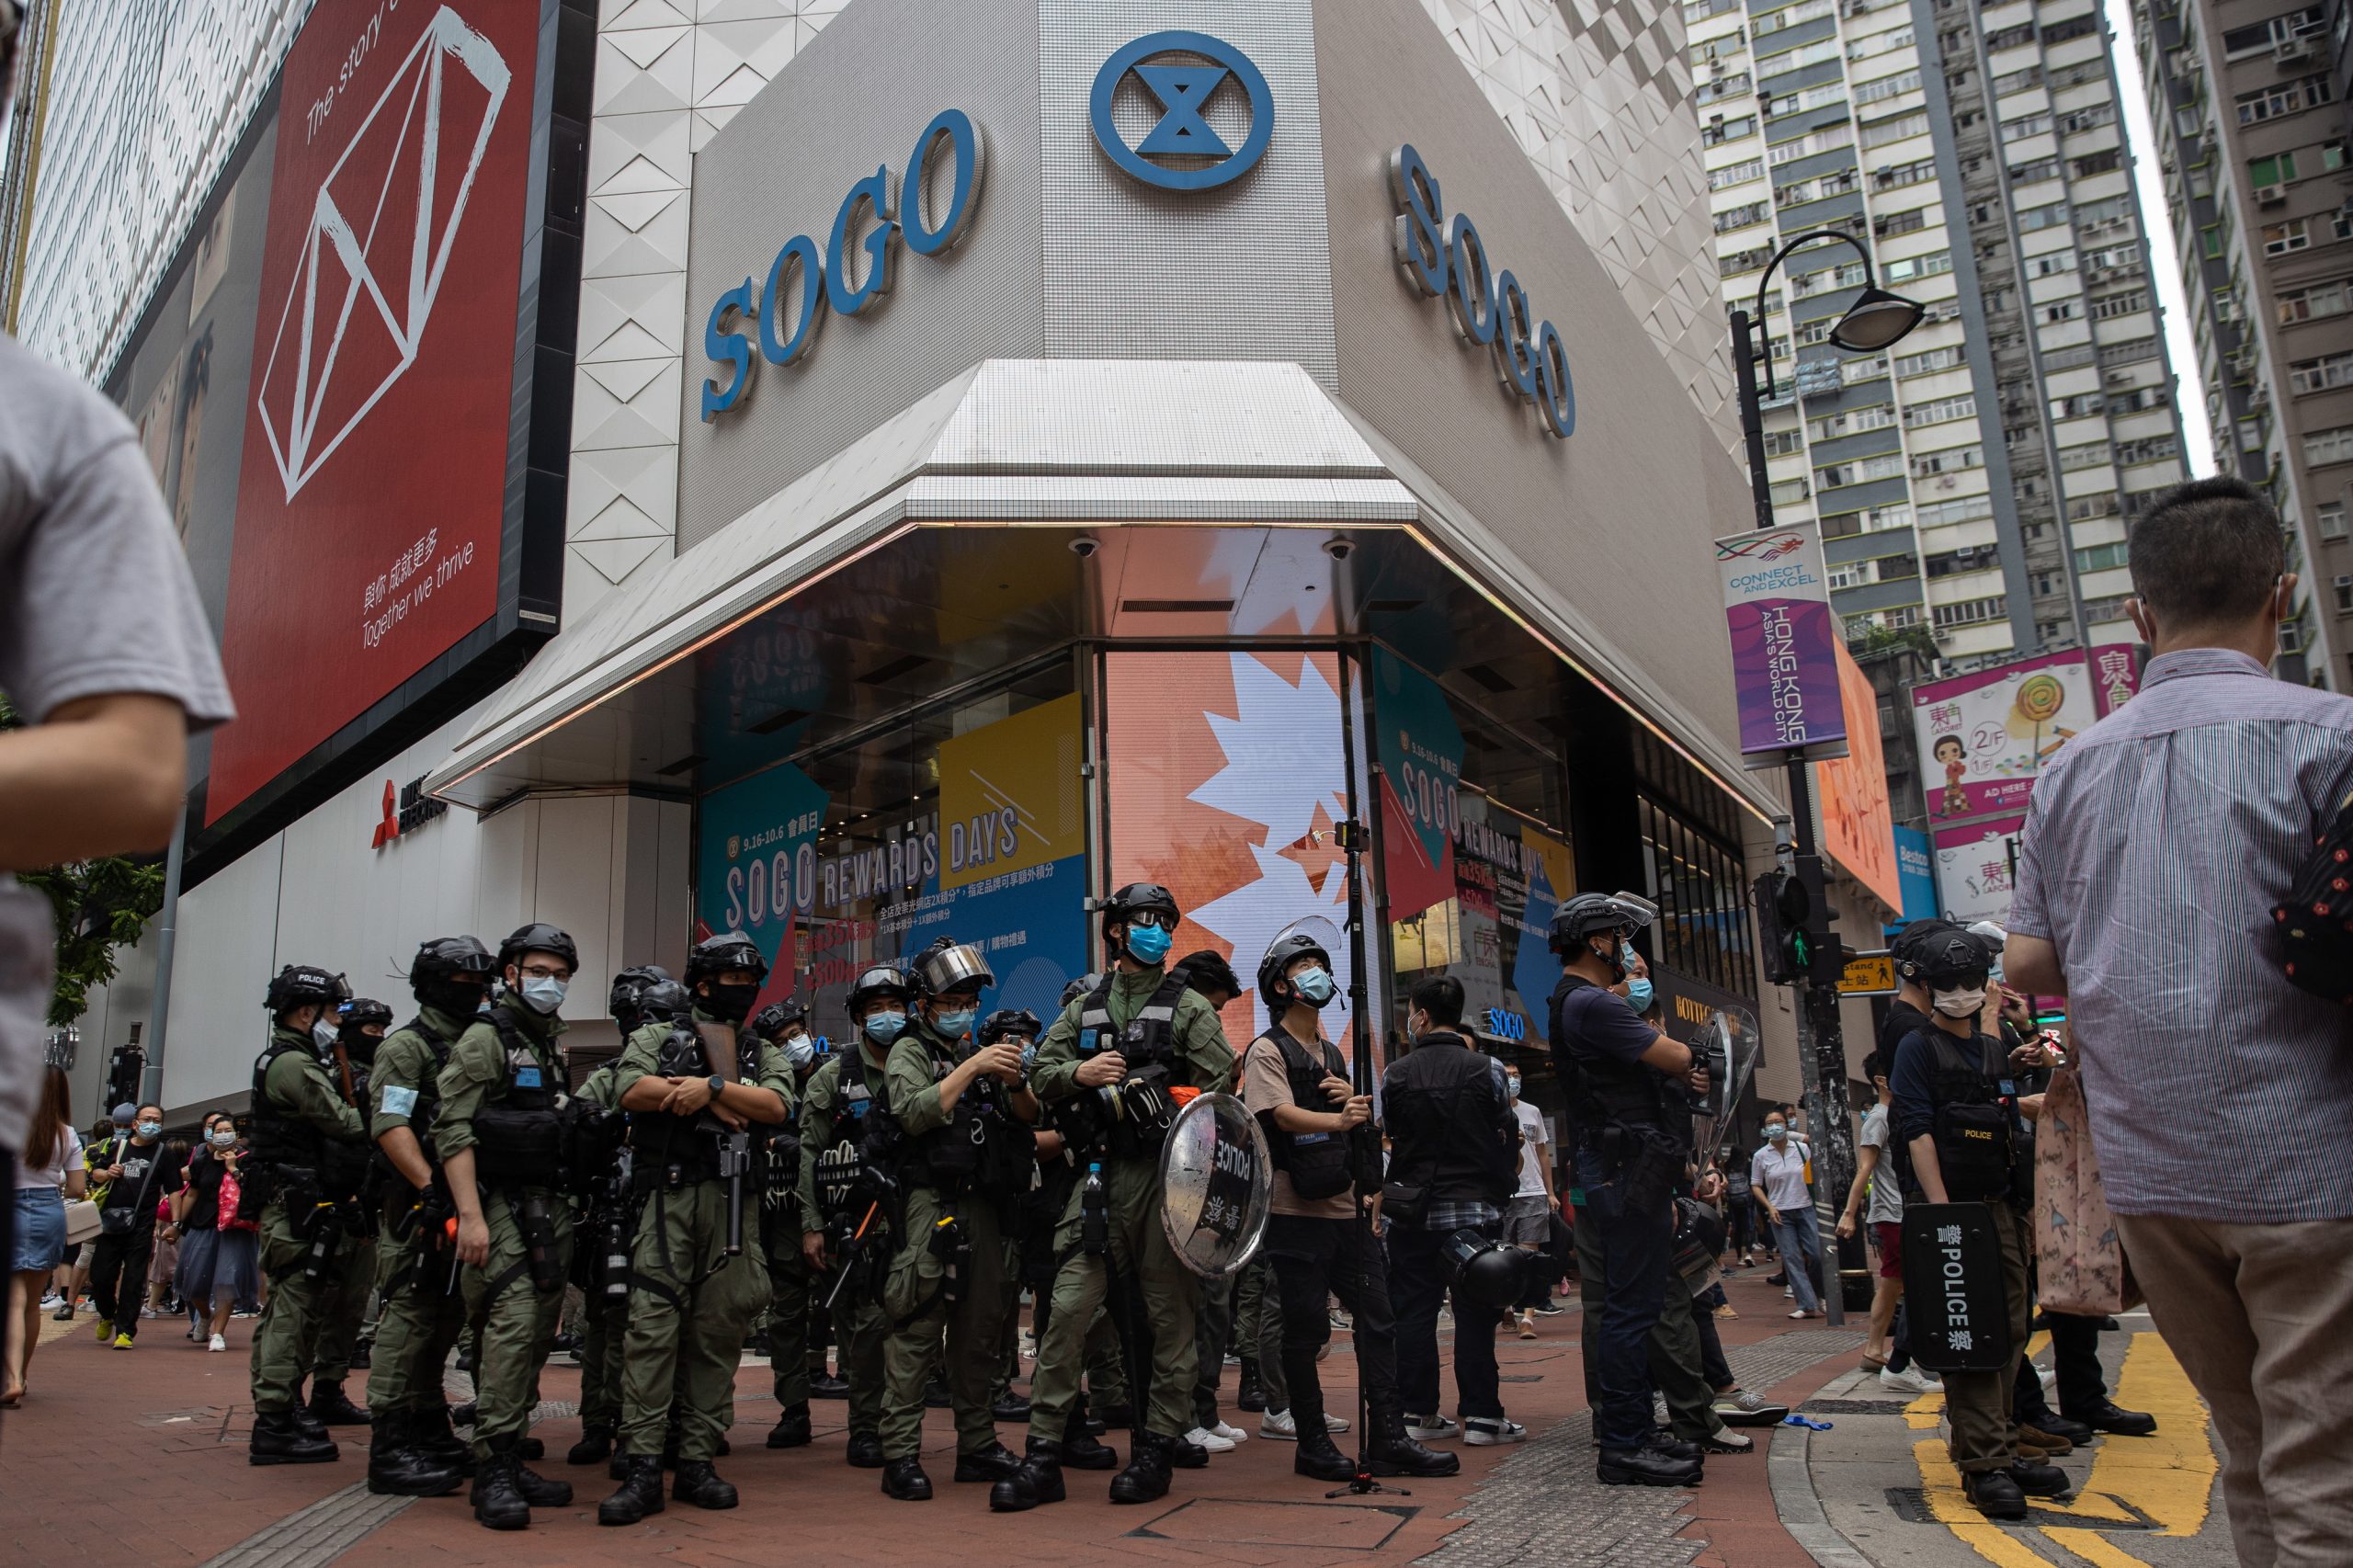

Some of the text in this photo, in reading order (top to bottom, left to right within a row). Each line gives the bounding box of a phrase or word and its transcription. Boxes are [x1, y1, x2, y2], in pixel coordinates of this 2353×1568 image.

[307, 1, 385, 145] The story
[702, 108, 983, 423] SOGO
[1391, 143, 1576, 438] SOGO
[364, 528, 438, 615] 與你 成就更多
[1730, 564, 1803, 589] CONNECT
[1744, 574, 1818, 595] AND EXCEL
[363, 541, 473, 649] Together we thrive
[1762, 611, 1789, 744] ASIA'S WORLD CITY
[1772, 606, 1807, 744] HONG KONG
[1928, 702, 1963, 729] 東角
[1974, 729, 2005, 750] 2/F
[1972, 759, 1991, 772] 1/F
[1403, 760, 1461, 845] SOGO
[1984, 788, 2001, 799] AD
[2001, 782, 2028, 795] HERE
[744, 810, 818, 852] 9.16-10.6 會員日
[1463, 814, 1545, 881] REWARDS DAYS
[726, 806, 1018, 930] SOGO REWARDS DAYS
[298, 973, 326, 984] POLICE
[1842, 974, 1870, 986] 士站
[1843, 962, 1873, 971] Stand
[1490, 1006, 1525, 1040] SOGO
[1965, 1130, 1993, 1140] POLICE
[1216, 1139, 1251, 1181] POLICE
[1205, 1195, 1241, 1231] 警察
[1936, 1224, 1973, 1351] 警 POLICE 察
